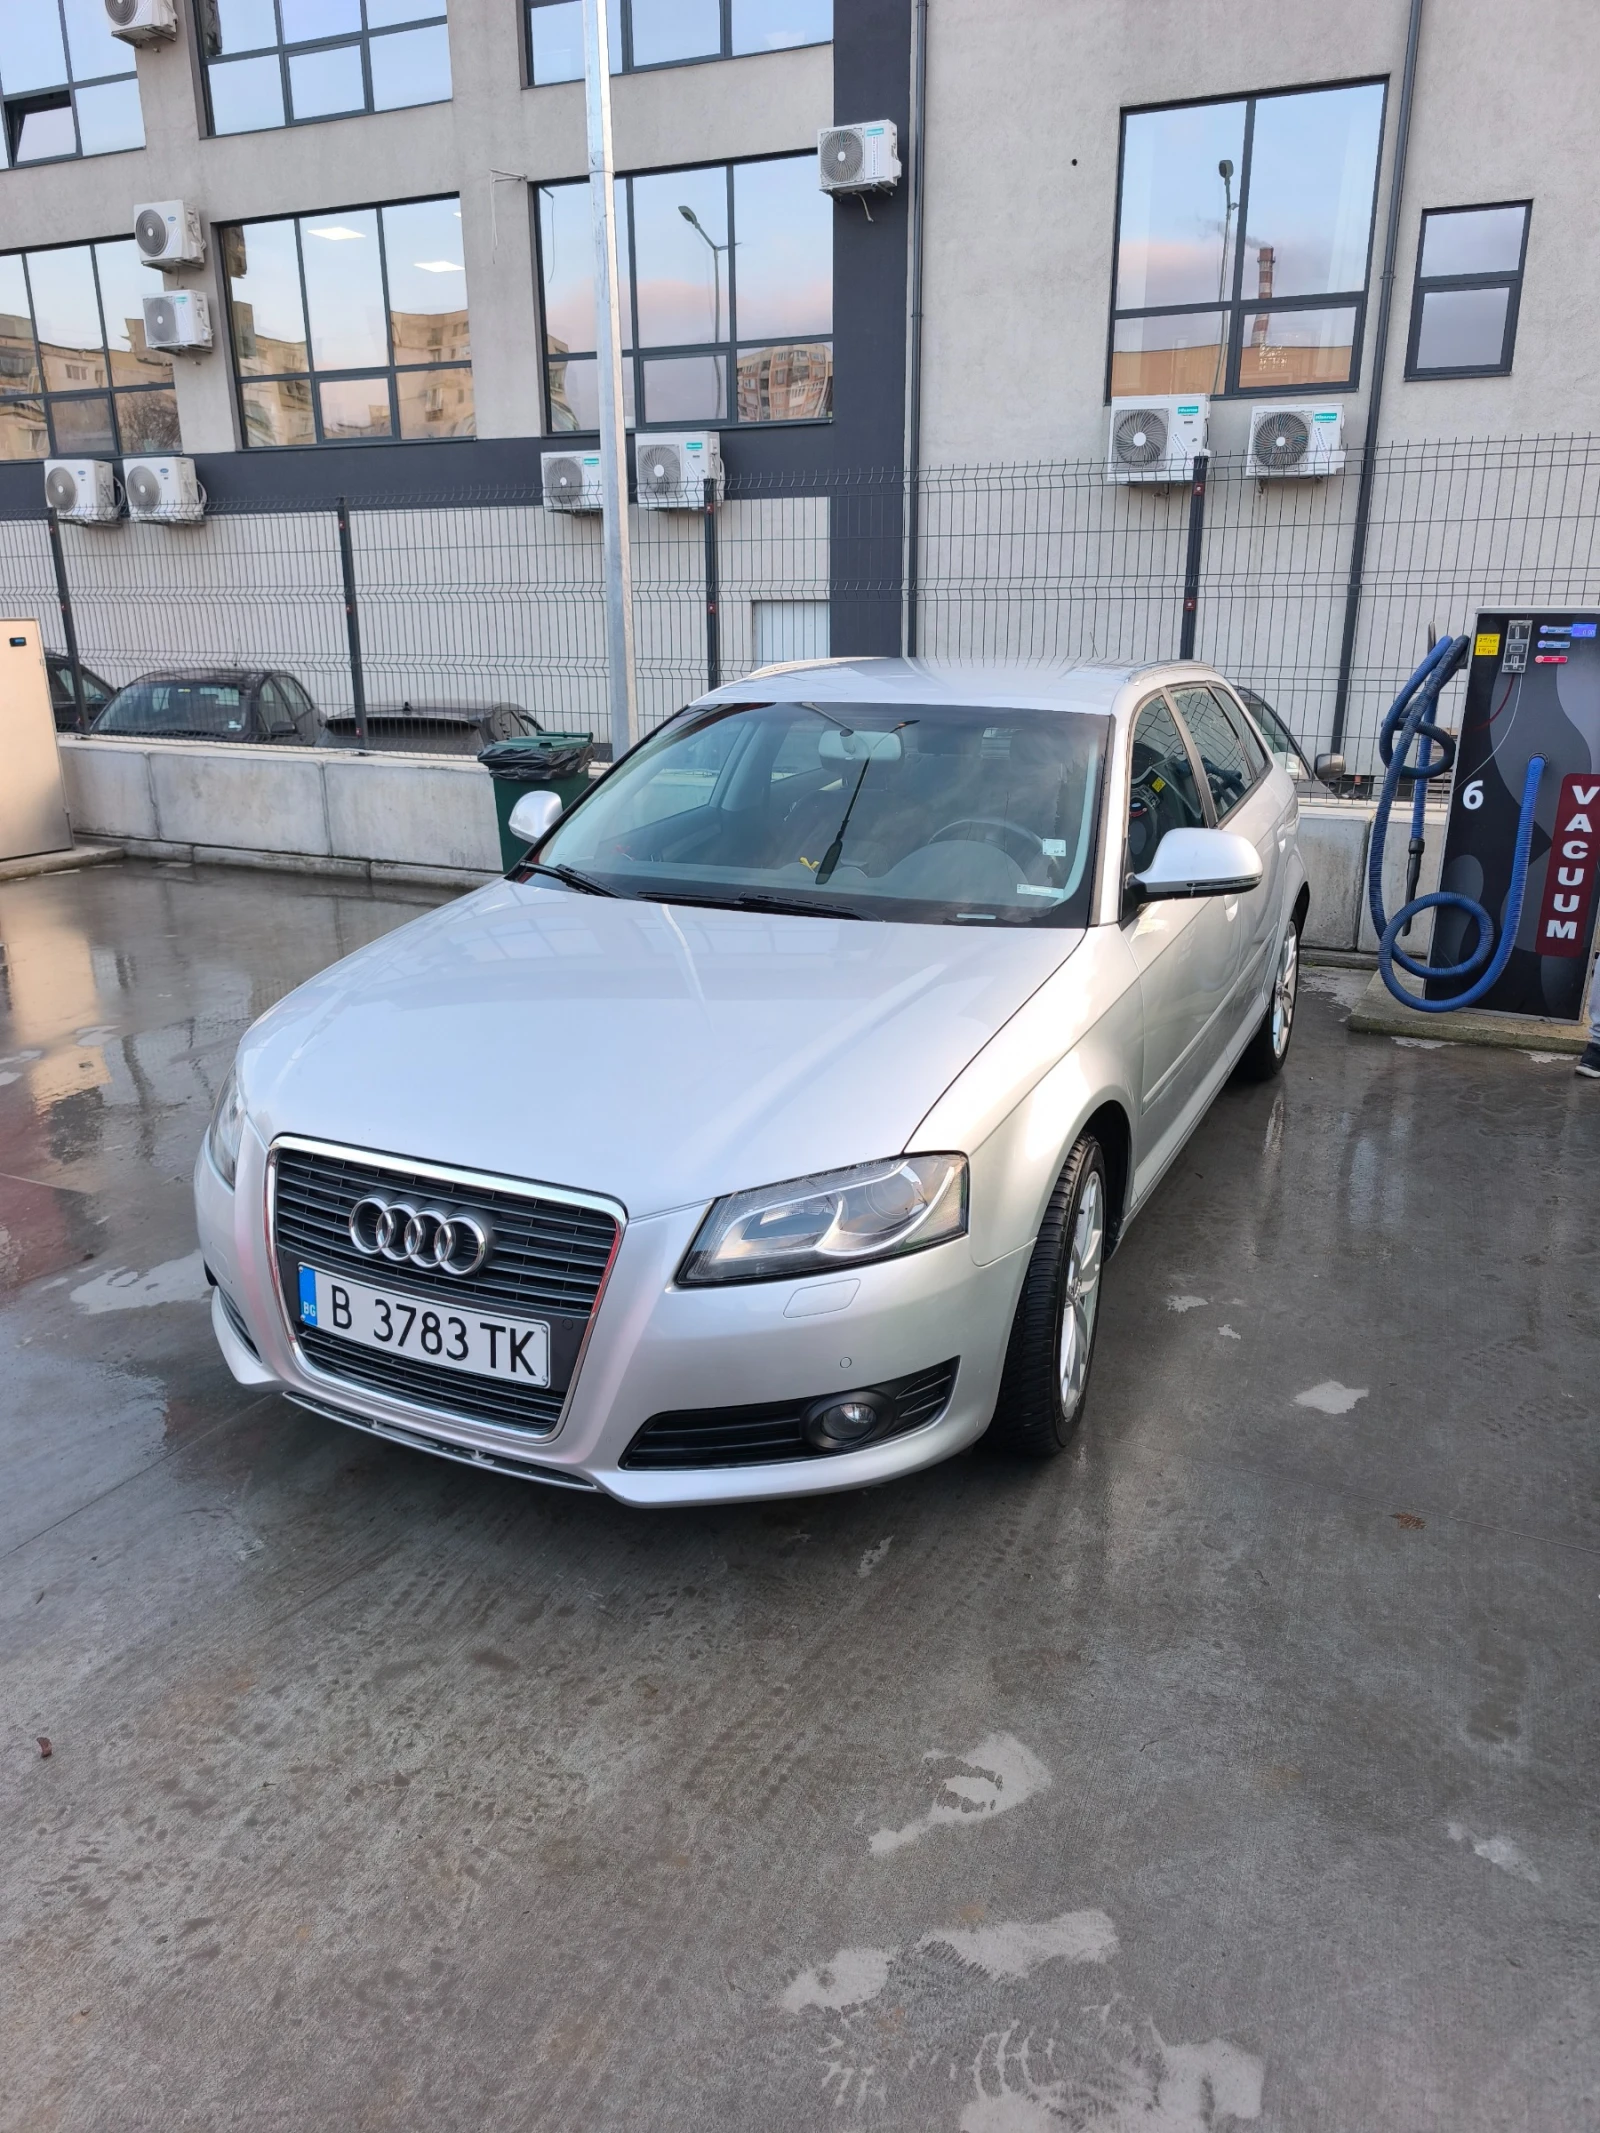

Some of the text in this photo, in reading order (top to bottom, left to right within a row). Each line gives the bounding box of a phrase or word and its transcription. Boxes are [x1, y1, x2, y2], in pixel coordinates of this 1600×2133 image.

[1462, 780, 1484, 810] 6
[1546, 785, 1600, 939] VACUUM
[303, 1301, 317, 1317] BG
[331, 1284, 536, 1377] B 3783 TK
